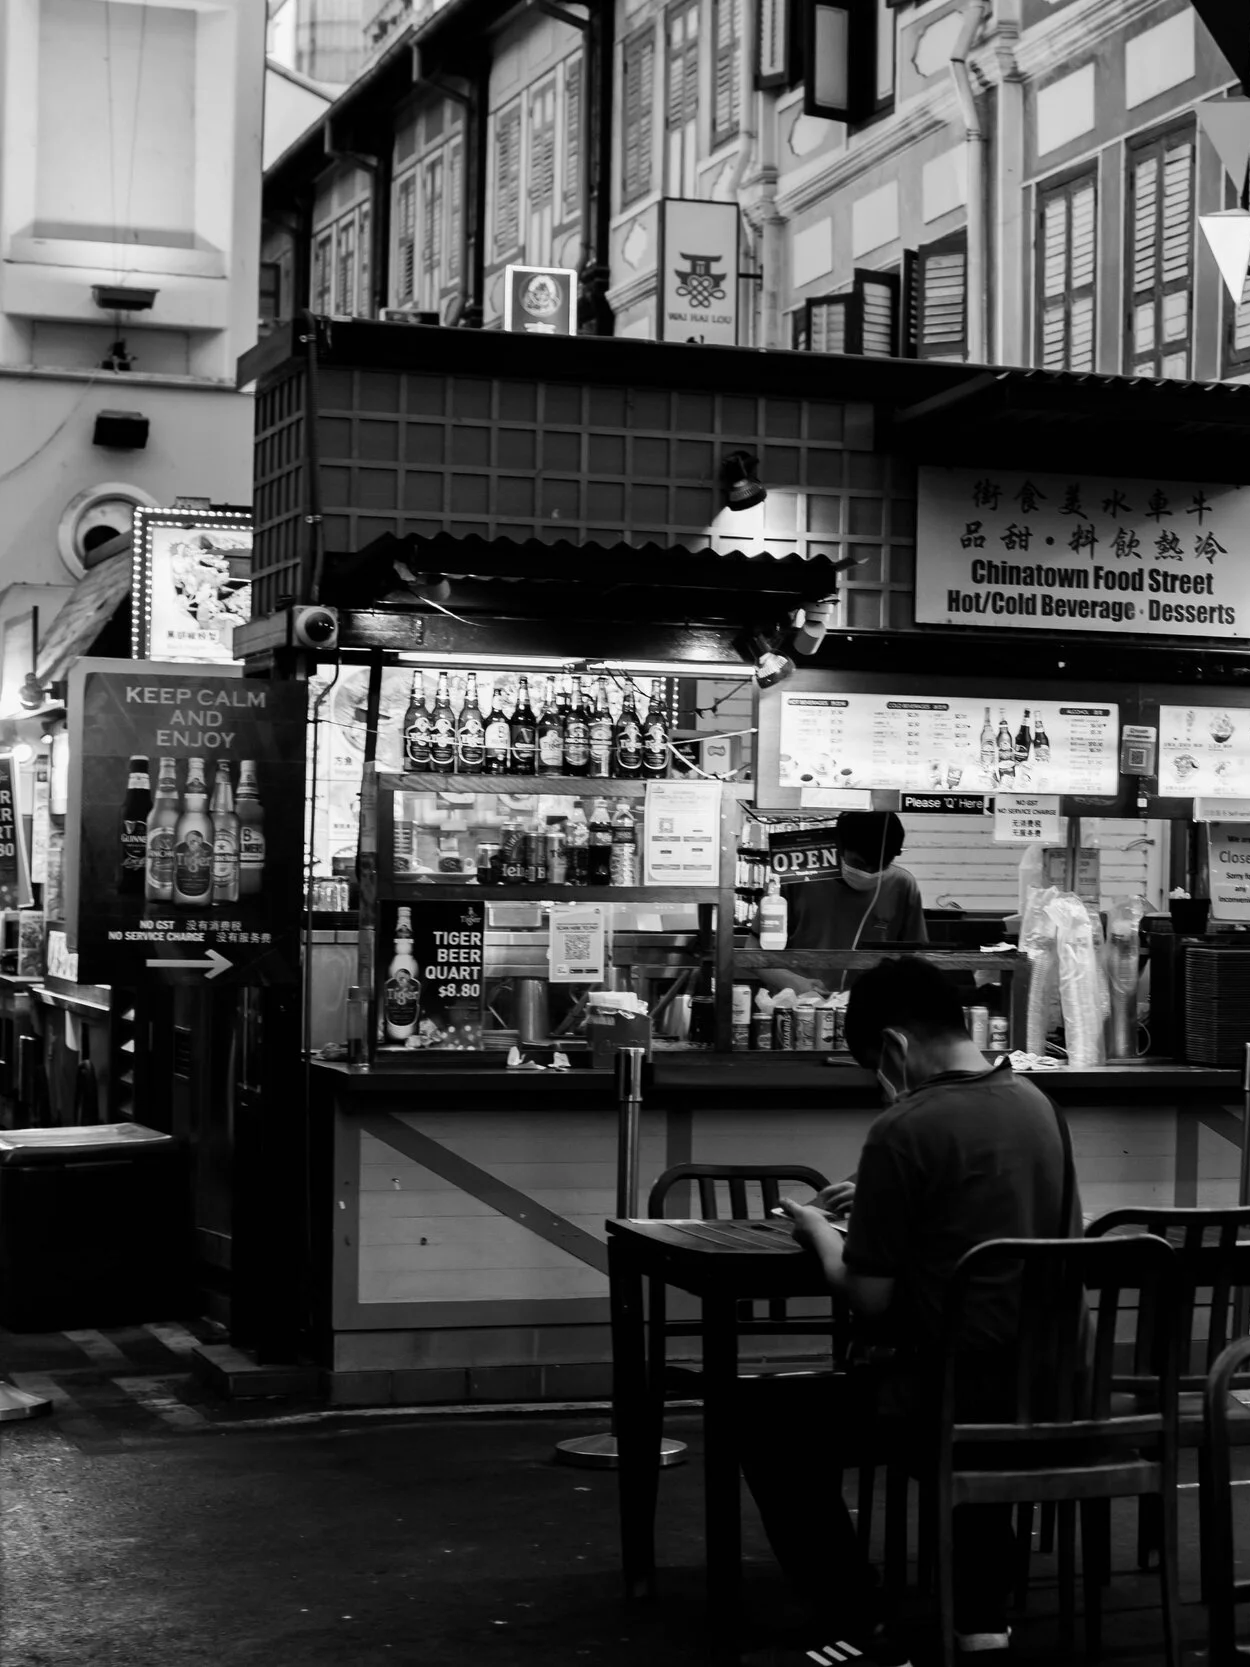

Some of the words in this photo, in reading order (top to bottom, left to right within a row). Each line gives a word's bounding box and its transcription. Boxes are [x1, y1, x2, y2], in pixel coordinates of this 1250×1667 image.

[971, 559, 1089, 590] Chinatown
[1093, 565, 1143, 592] Food
[1148, 569, 1214, 595] Street
[947, 590, 1037, 616] Hot/Cold
[1041, 594, 1135, 621] Beverage
[1148, 599, 1235, 625] Desserts
[126, 686, 192, 705] KEEP
[197, 689, 266, 708] CALM
[170, 710, 223, 727] AND
[156, 729, 236, 748] ENJOY
[905, 797, 941, 808] Please
[958, 798, 983, 808] Here
[773, 848, 838, 872] OPEN
[1226, 872, 1243, 880] Sorry
[139, 920, 154, 929] NO
[155, 920, 175, 930] GST
[108, 931, 123, 940] NO
[124, 931, 165, 941] SERVICE
[166, 932, 205, 942] CHARGE
[432, 931, 482, 945] TIGER
[437, 949, 482, 962] BEER
[425, 966, 481, 980] QUART
[438, 984, 480, 998] $8.80
